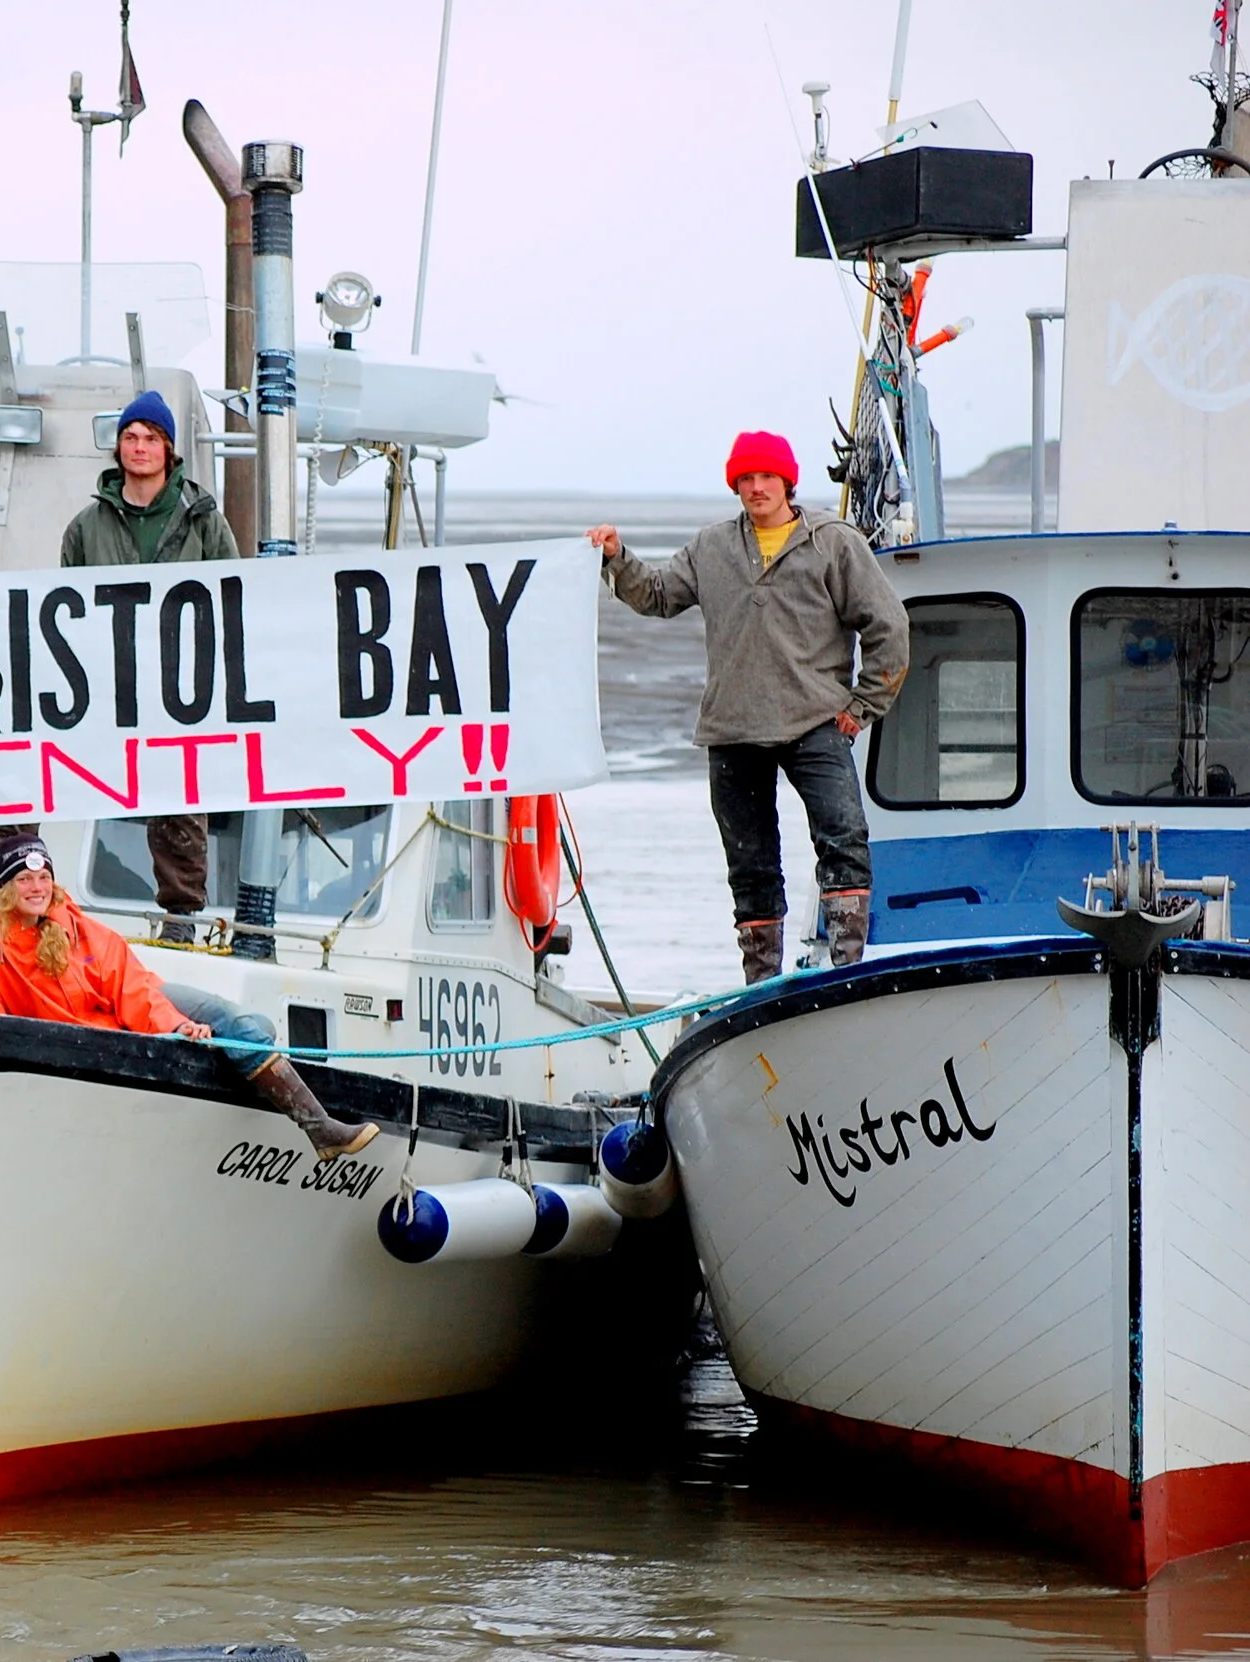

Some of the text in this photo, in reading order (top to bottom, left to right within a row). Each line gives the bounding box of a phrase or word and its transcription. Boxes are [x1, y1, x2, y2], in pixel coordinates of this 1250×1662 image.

[335, 559, 537, 719] BAY
[418, 976, 501, 1077] 46962
[217, 1141, 384, 1199] CAROL SUSAN
[786, 1056, 997, 1208] Mistral
